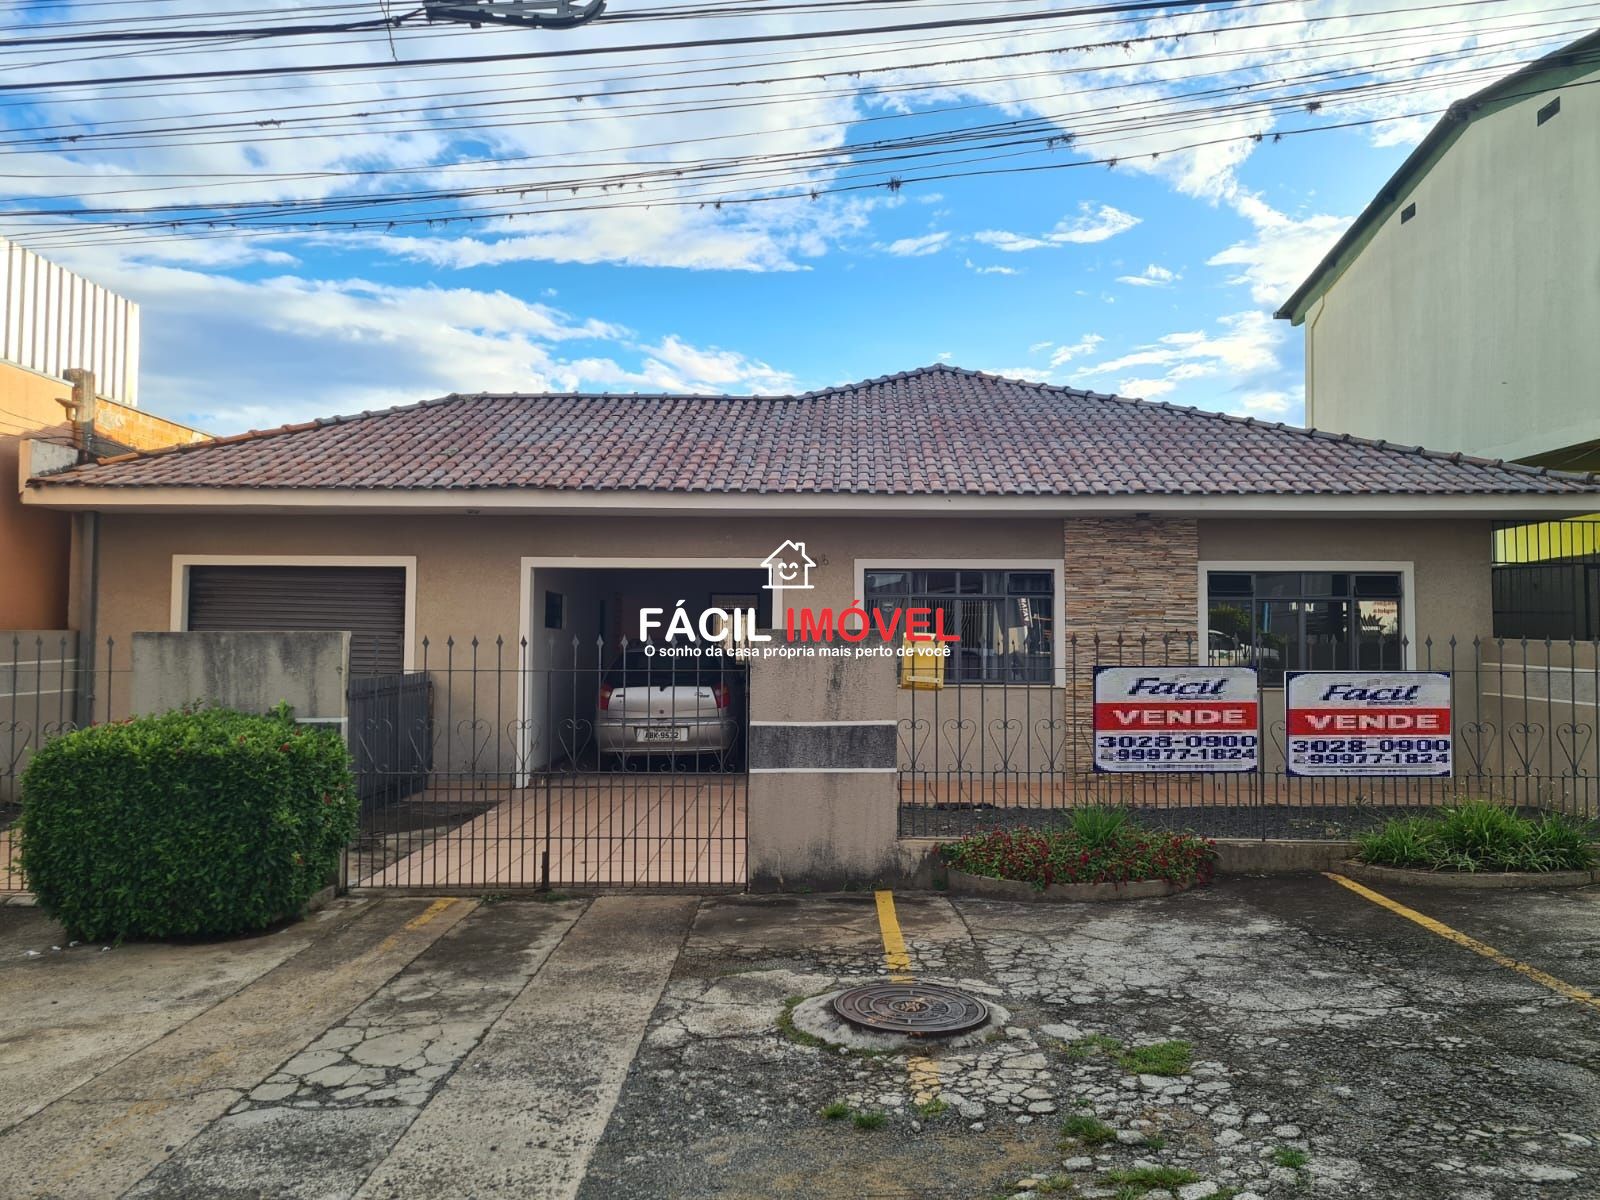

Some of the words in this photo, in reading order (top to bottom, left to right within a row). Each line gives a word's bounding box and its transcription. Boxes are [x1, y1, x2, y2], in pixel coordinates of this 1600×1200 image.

[1112, 709, 1247, 725] VENDE
[1305, 714, 1440, 731] VENDE
[1099, 735, 1257, 748] 3028-0900
[1292, 740, 1450, 753] 3028-0900
[1117, 749, 1255, 760] 99977-1824
[1310, 753, 1448, 764] 99977-1824
